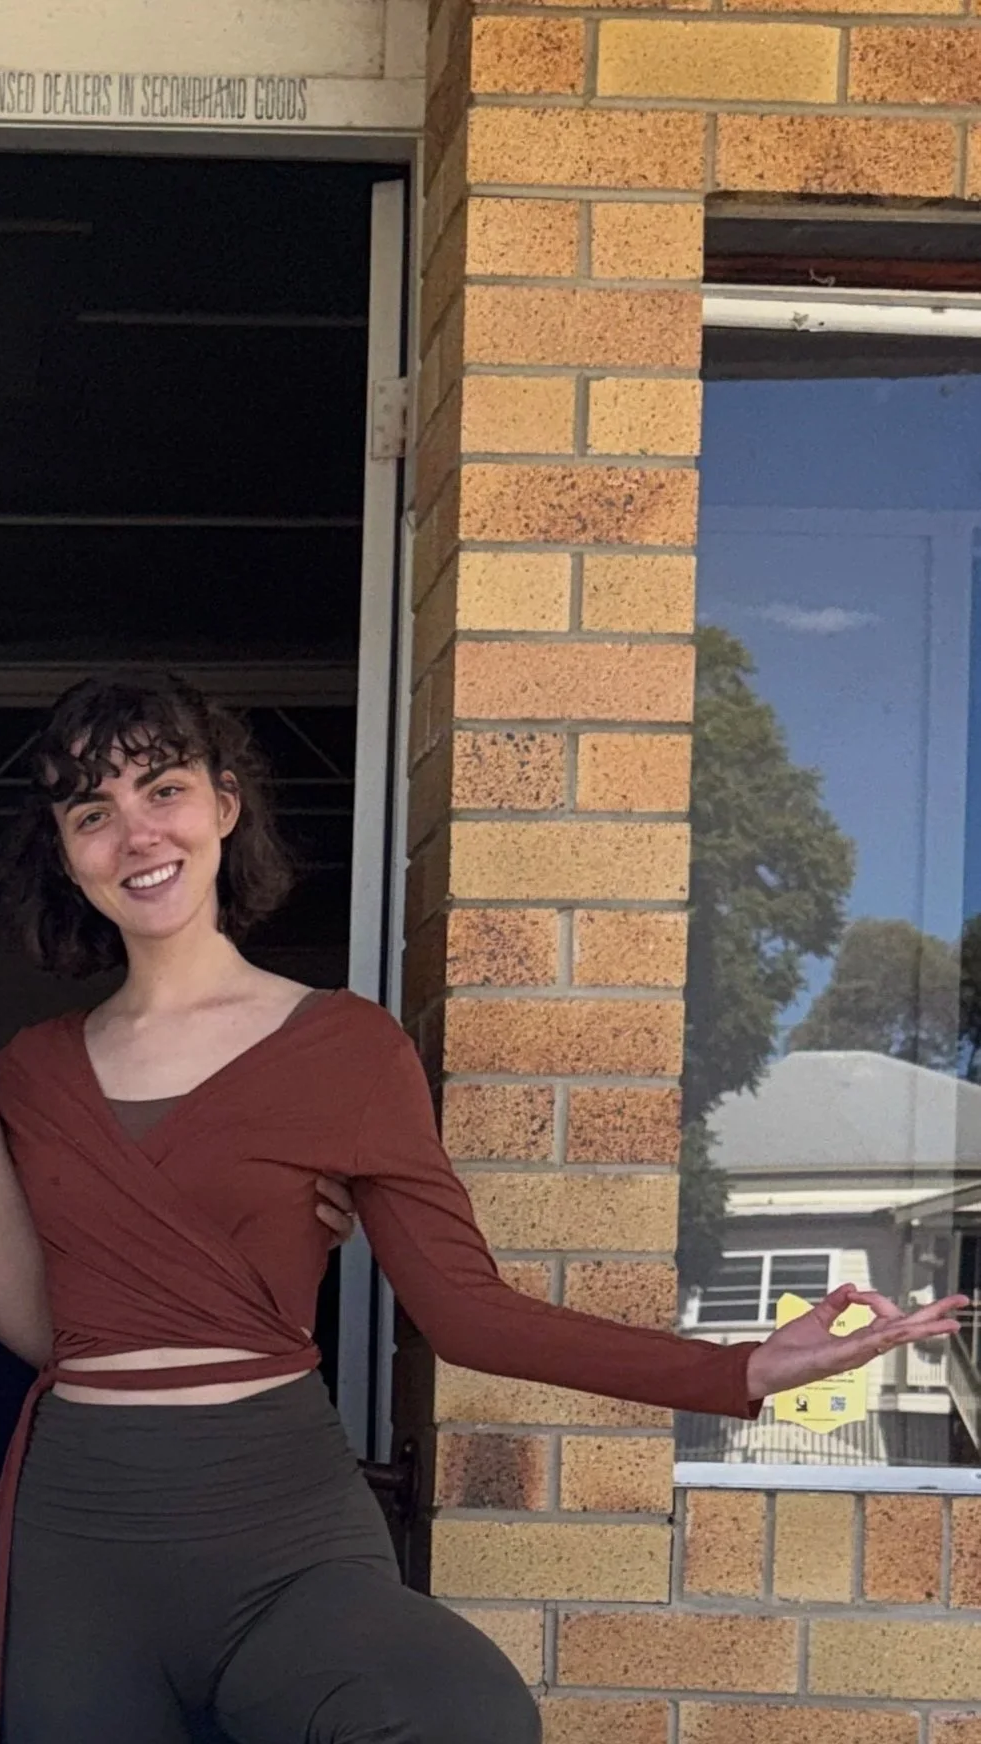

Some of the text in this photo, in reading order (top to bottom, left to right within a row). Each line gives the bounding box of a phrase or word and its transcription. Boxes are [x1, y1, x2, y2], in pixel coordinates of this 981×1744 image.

[43, 73, 112, 115] DEALERS
[119, 74, 135, 116] IN
[141, 75, 247, 119] SECONDHAND
[254, 77, 307, 121] GOODS
